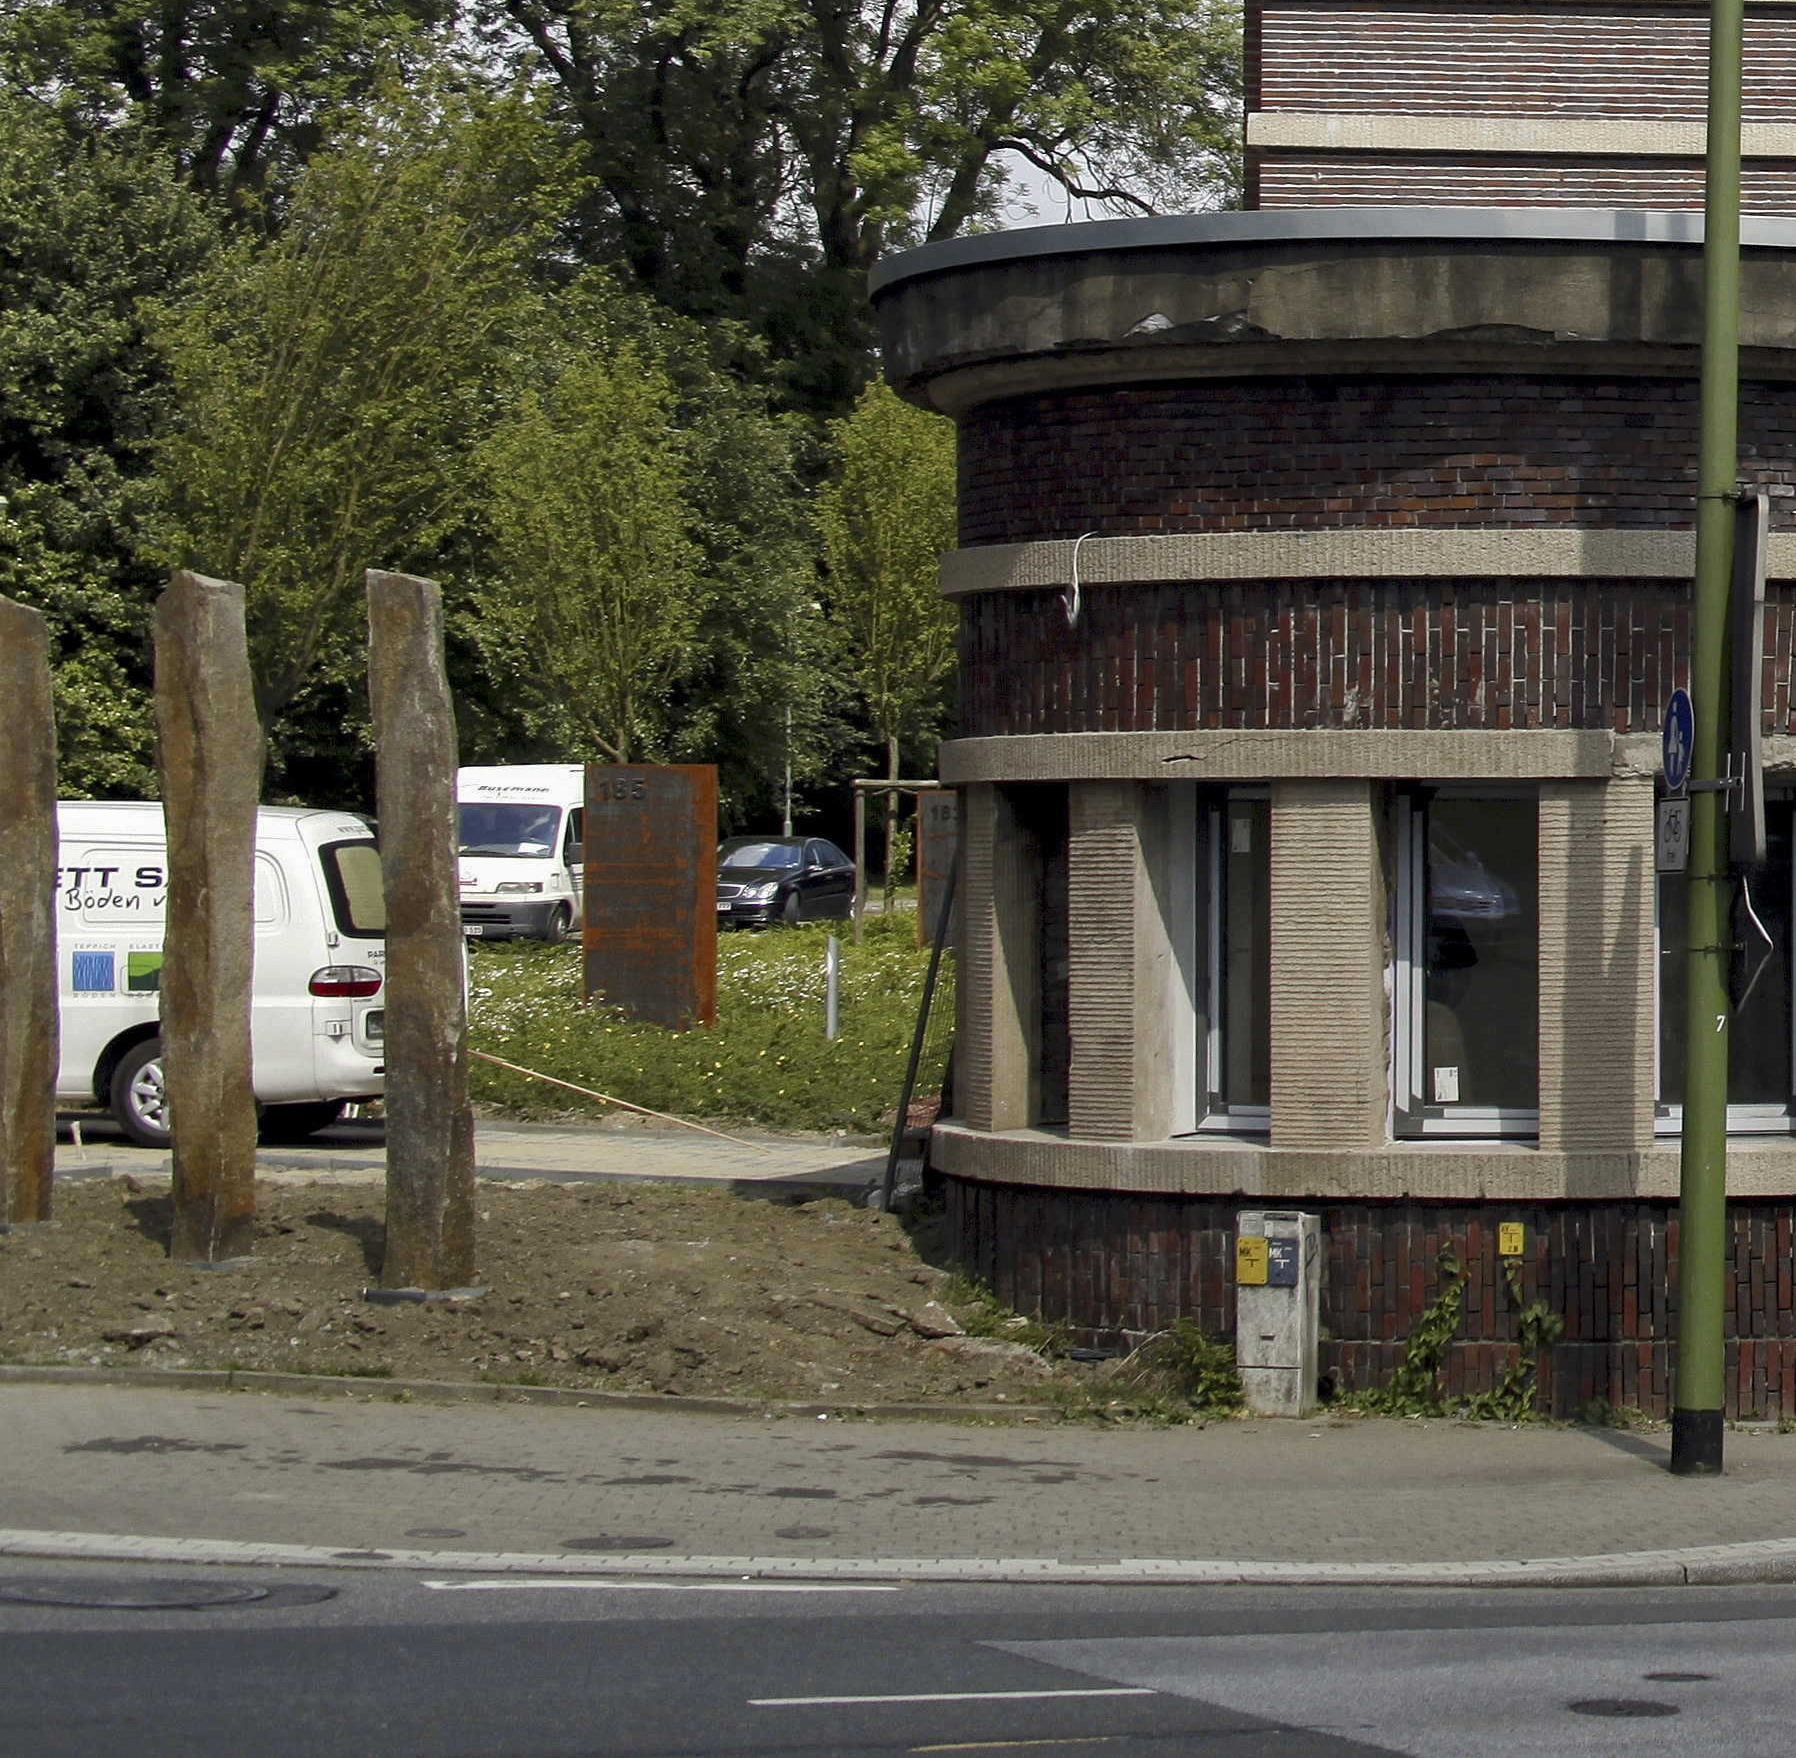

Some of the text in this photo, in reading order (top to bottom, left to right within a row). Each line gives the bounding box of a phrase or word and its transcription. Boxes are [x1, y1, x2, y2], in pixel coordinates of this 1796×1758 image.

[600, 777, 646, 800] 185
[135, 867, 168, 888] S
[64, 887, 140, 911] Böden
[73, 991, 117, 999] BÖDEN
[1716, 1015, 1726, 1032] 7
